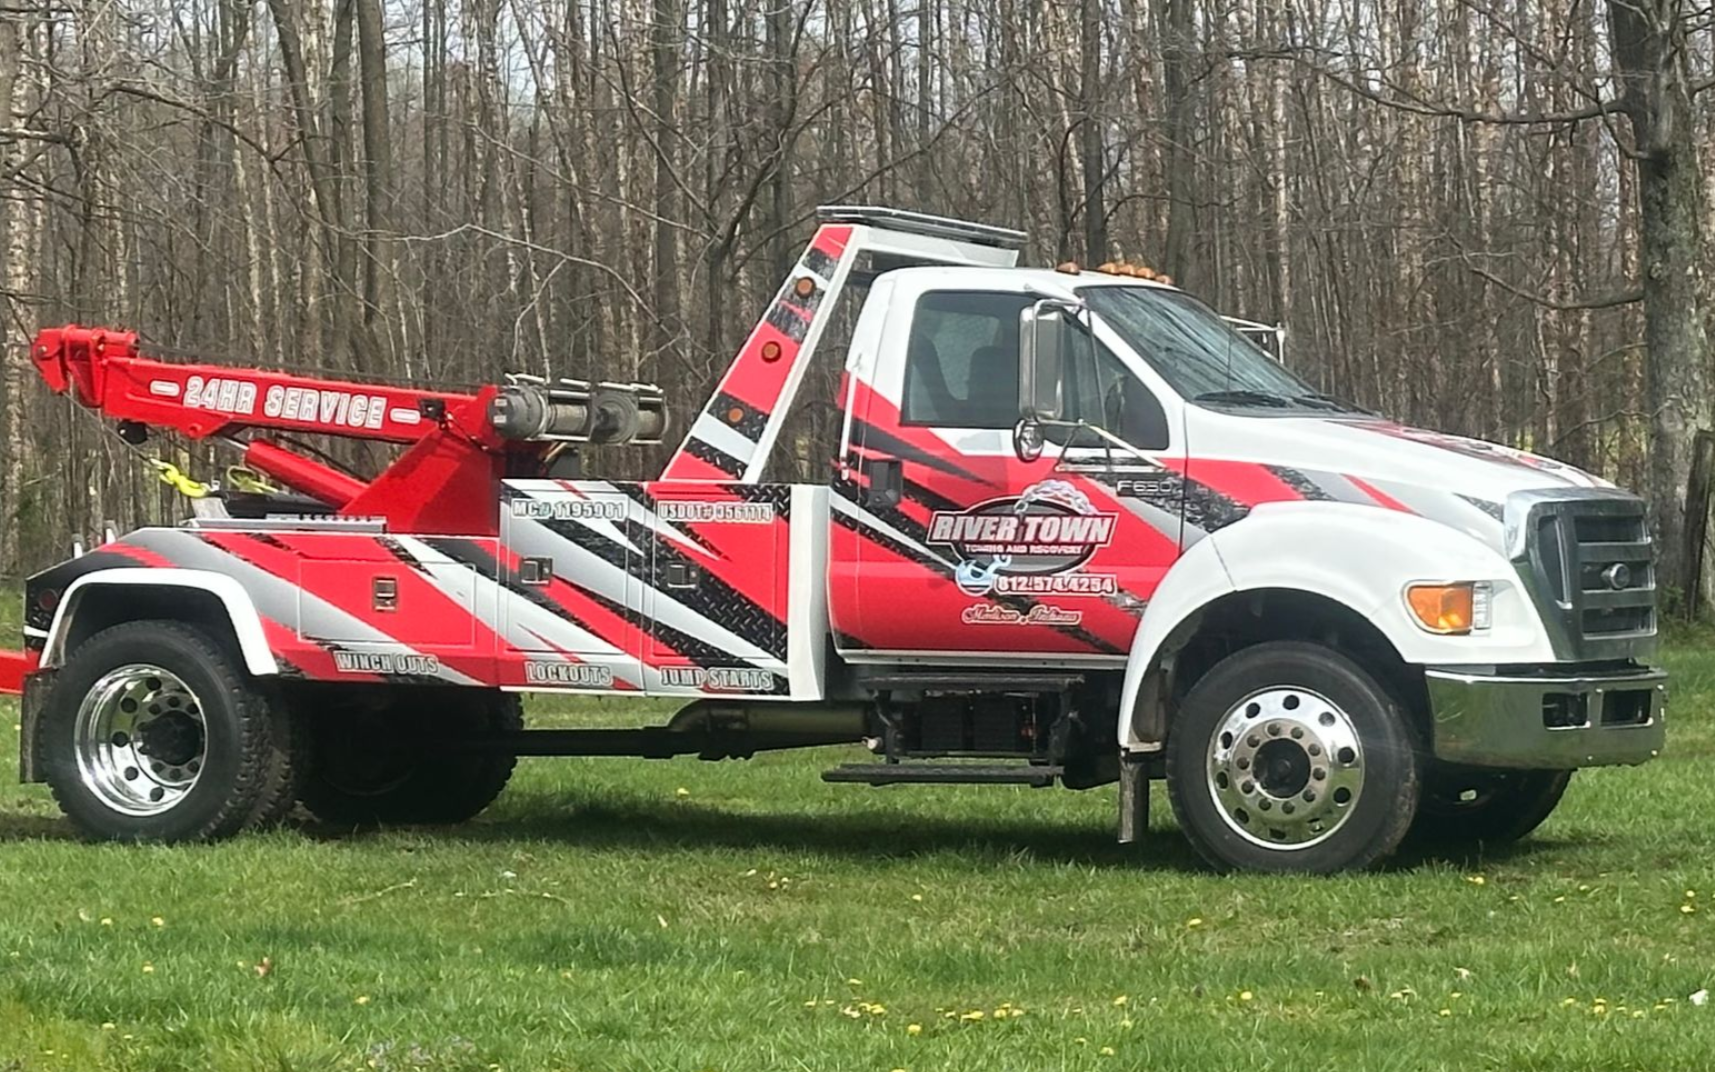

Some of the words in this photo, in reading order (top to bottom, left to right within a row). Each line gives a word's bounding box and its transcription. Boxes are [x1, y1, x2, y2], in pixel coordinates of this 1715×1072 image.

[183, 376, 257, 414] 24HR
[264, 386, 387, 429] SERVICE
[512, 500, 552, 518] MC#
[658, 502, 714, 520] USDOT#
[932, 515, 1019, 541] RIVER
[1024, 516, 1113, 543] TOWN
[964, 544, 1005, 554] TOWING
[1006, 545, 1028, 554] AND
[1029, 545, 1084, 555] RECOVERY
[335, 652, 394, 672] WINCH
[395, 654, 439, 675] OUTS
[526, 663, 613, 686] LOCKOUTS
[660, 668, 706, 688] JUMP
[708, 669, 774, 690] STARTS
